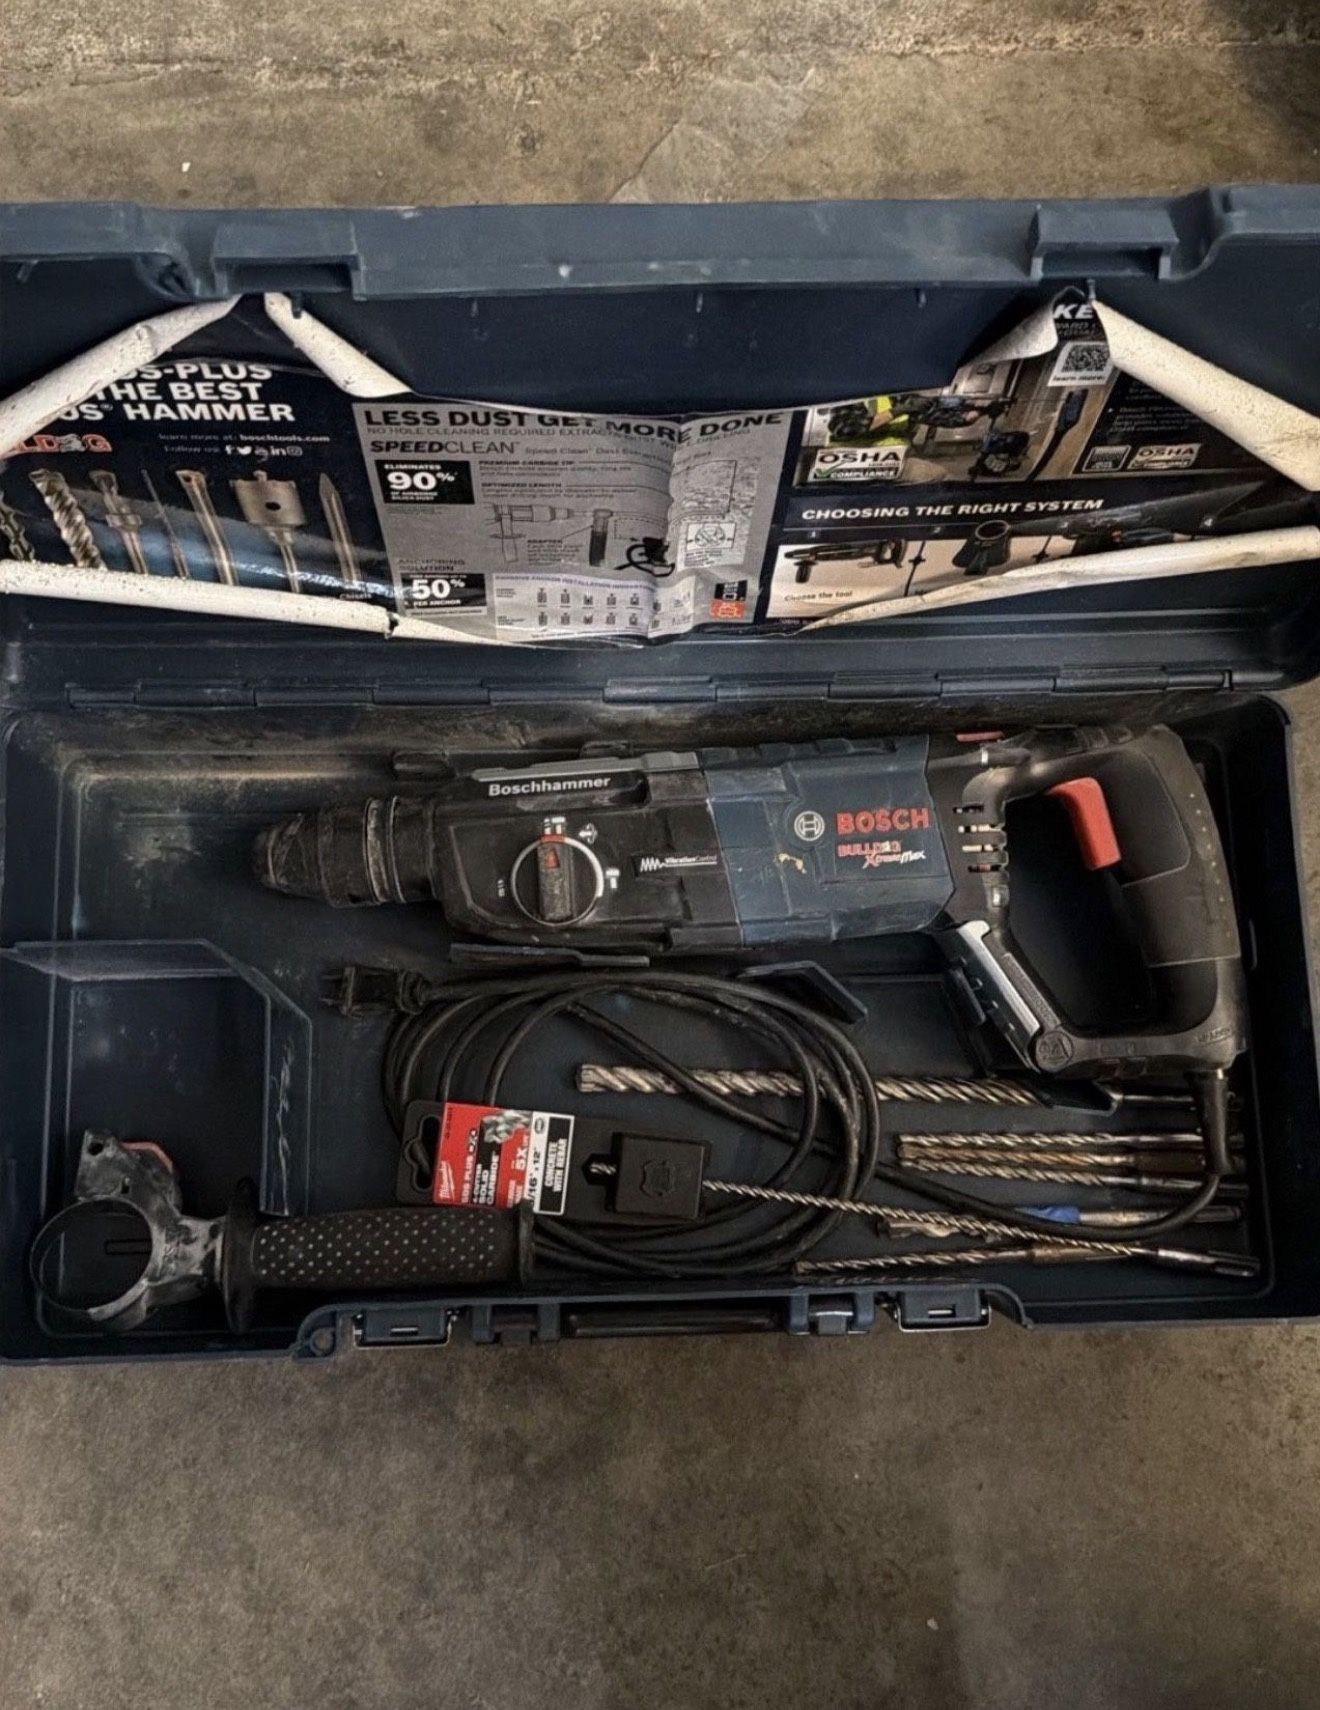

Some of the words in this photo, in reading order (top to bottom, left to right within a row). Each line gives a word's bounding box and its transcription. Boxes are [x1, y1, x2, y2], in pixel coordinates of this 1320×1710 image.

[169, 382, 262, 401] BEST
[125, 402, 295, 422] HAMMER
[364, 409, 440, 427] LESS
[449, 410, 530, 428] DUST
[605, 419, 692, 444] MORE
[699, 411, 783, 437] DONE
[367, 427, 385, 435] NO
[389, 427, 423, 435] HOLE
[426, 427, 489, 436] CLEANING
[493, 427, 555, 437] REQUIRED
[818, 451, 901, 464] OSHA
[830, 470, 895, 479] COMPLIANCE
[802, 506, 910, 520] CHOOSING
[915, 503, 952, 516] THE
[957, 501, 1019, 515] RIGHT
[1024, 499, 1103, 512] SYSTEM
[411, 578, 465, 600] 50%
[818, 591, 834, 599] the
[836, 589, 853, 598] tool
[488, 776, 611, 797] Boschhammer
[836, 807, 929, 835] BOSCH
[543, 1141, 557, 1187] CONCRETE
[554, 1138, 567, 1169] REBAR
[464, 1155, 474, 1181] PLUS
[479, 1169, 489, 1204] SOLID
[553, 1169, 564, 1192] WITH
